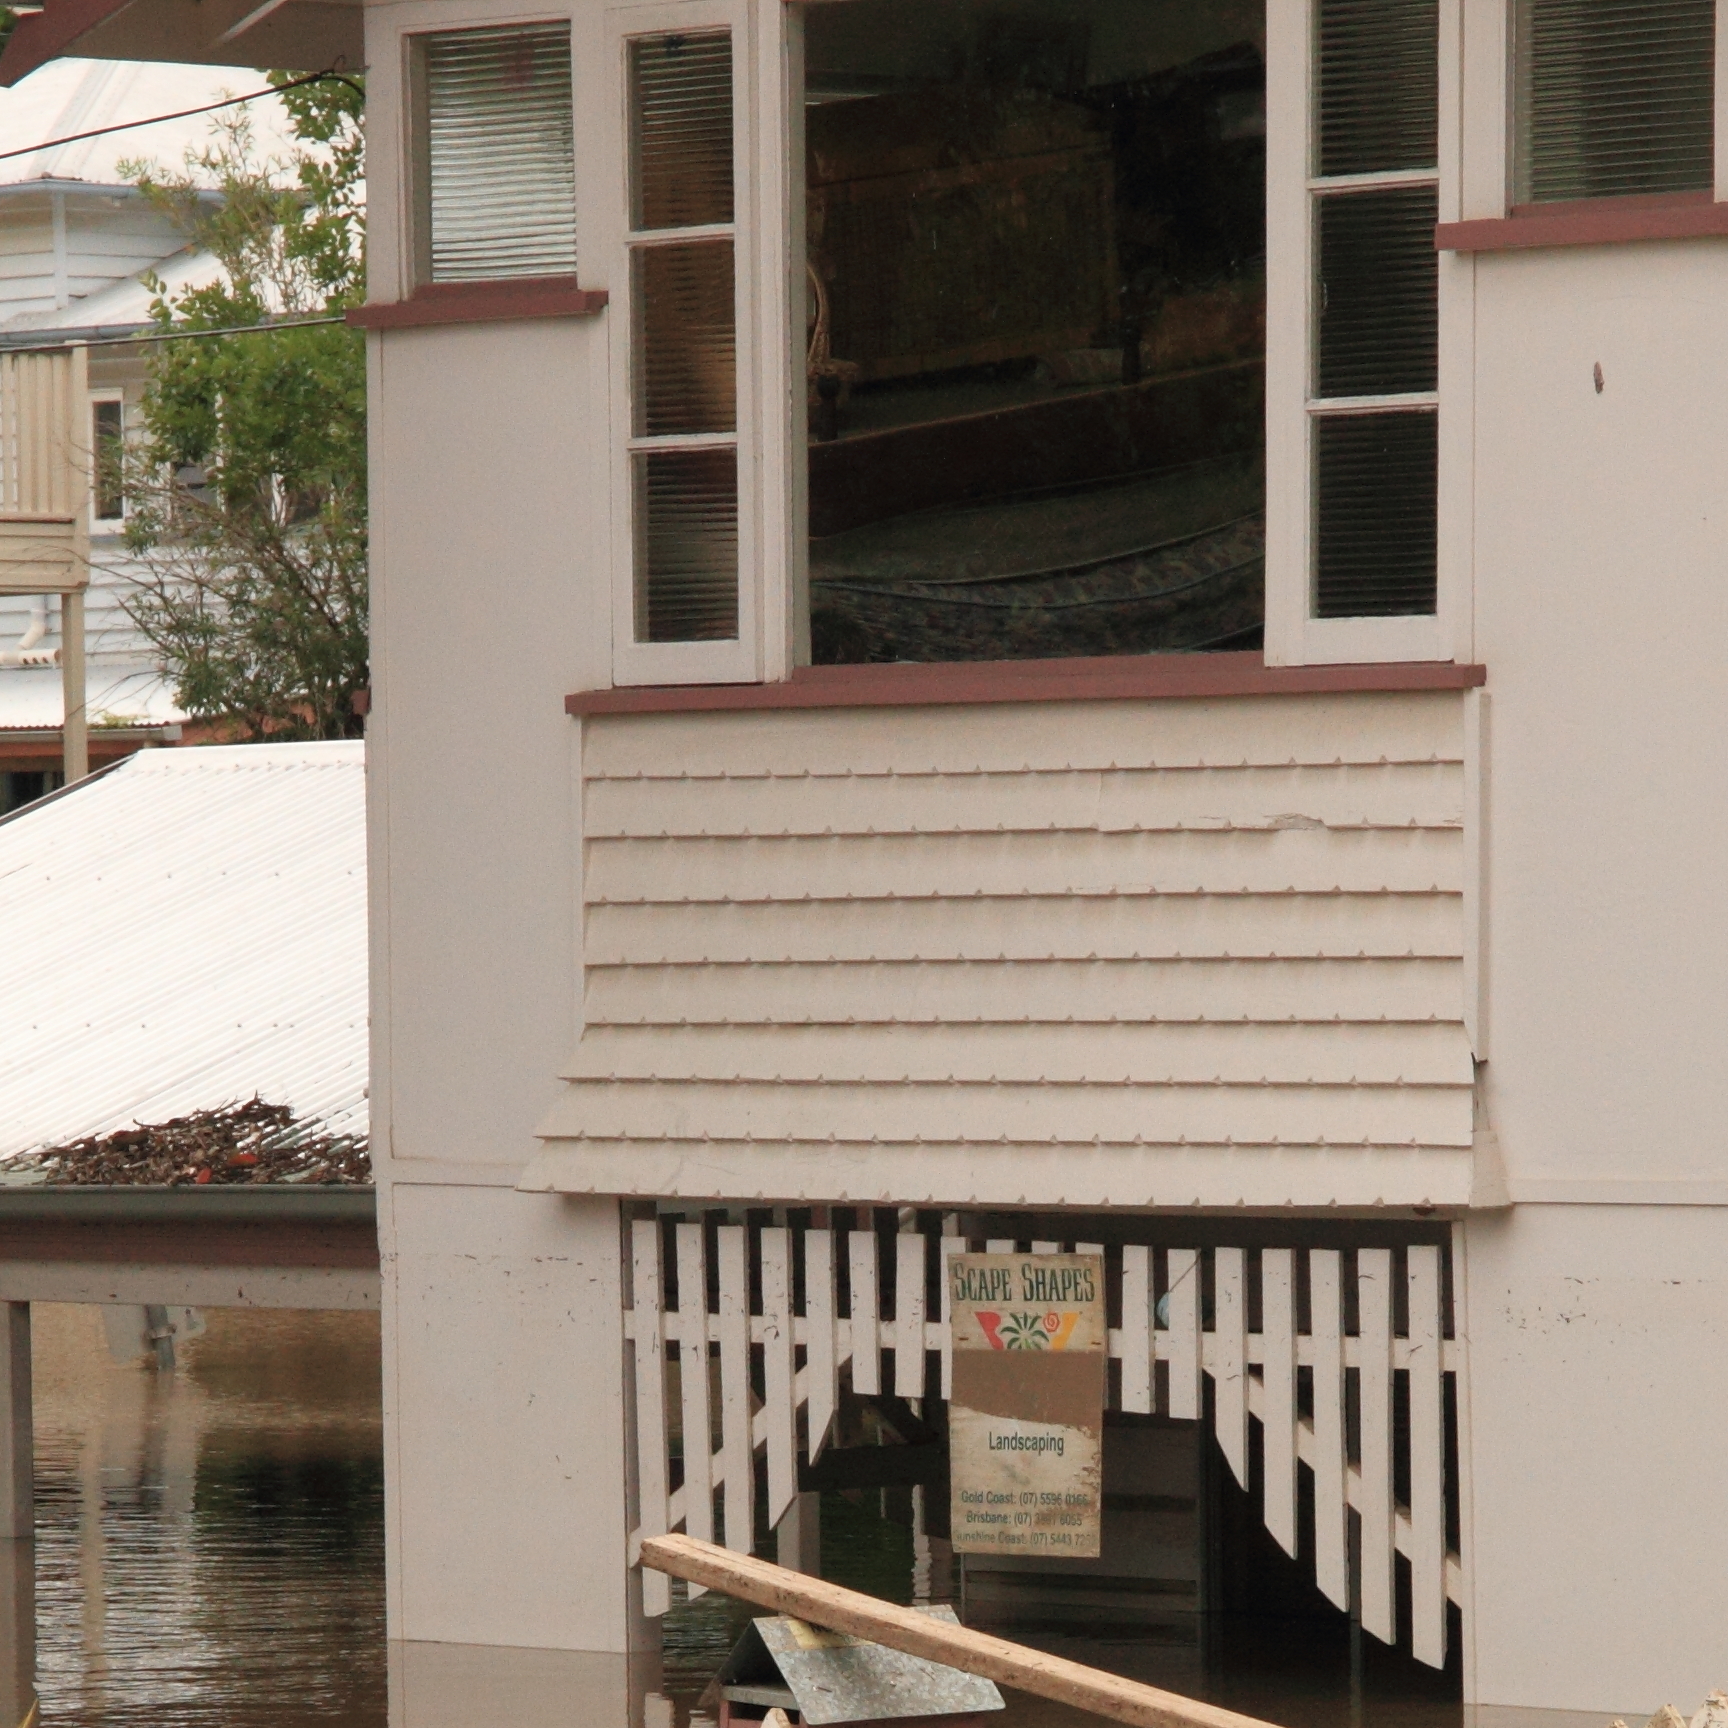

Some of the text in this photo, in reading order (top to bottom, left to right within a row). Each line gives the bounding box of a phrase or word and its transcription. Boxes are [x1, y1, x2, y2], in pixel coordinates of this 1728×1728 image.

[955, 1262, 1095, 1302] SCAPE SHAPES
[988, 1431, 1065, 1457] Landscaping
[961, 1490, 983, 1504] Gold
[1019, 1492, 1038, 1508] (07)
[966, 1510, 1012, 1525] Brisbane:
[1014, 1511, 1032, 1527] (07)
[954, 1529, 995, 1544] unshine
[1030, 1531, 1048, 1547] (07)
